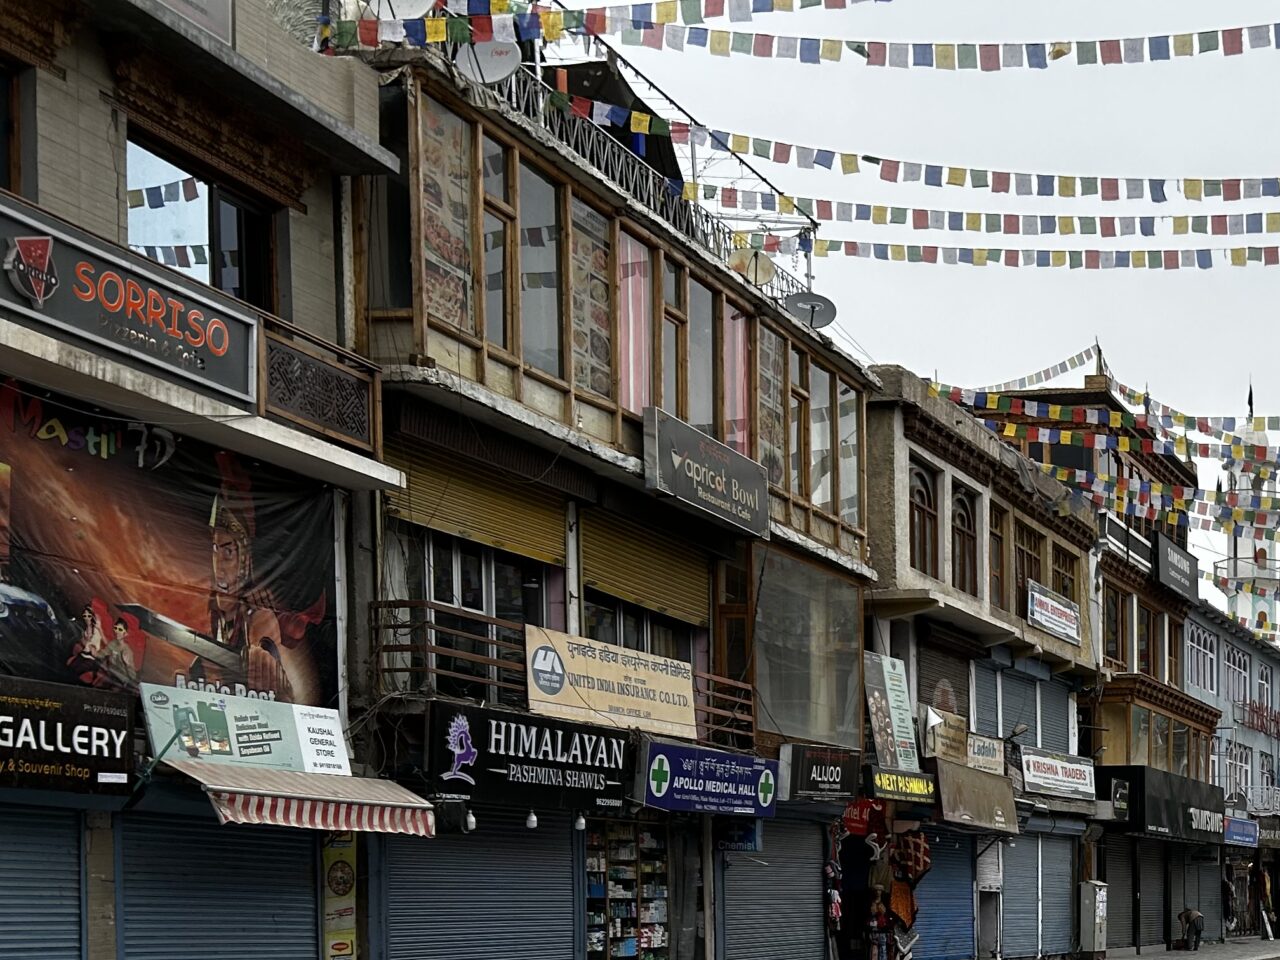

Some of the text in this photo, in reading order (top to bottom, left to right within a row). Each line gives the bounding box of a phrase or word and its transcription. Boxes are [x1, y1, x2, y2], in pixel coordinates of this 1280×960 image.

[72, 261, 230, 357] SORRISO
[684, 459, 759, 511] apricot Bowl
[697, 485, 731, 512] Restaurant
[732, 505, 737, 515] &
[568, 672, 596, 691] UNITED
[597, 679, 616, 693] INDIA
[617, 682, 657, 702] INSURANCE
[309, 737, 336, 748] GENERAL
[316, 749, 335, 757] STORE
[487, 719, 625, 770] HIMALAYAN
[973, 737, 997, 758] Ladakh
[7, 758, 15, 772] &
[18, 760, 63, 776] Souvenir
[65, 764, 90, 780] Shop
[508, 763, 606, 790] PASHMINA SHAWLS
[810, 765, 842, 782] ALIJOO
[1032, 760, 1059, 777] KRISHNA
[1060, 766, 1087, 781] TRADERS
[673, 776, 756, 796] APOLLO MEDICAL HALL
[880, 772, 928, 795] NEXT PASHMINA
